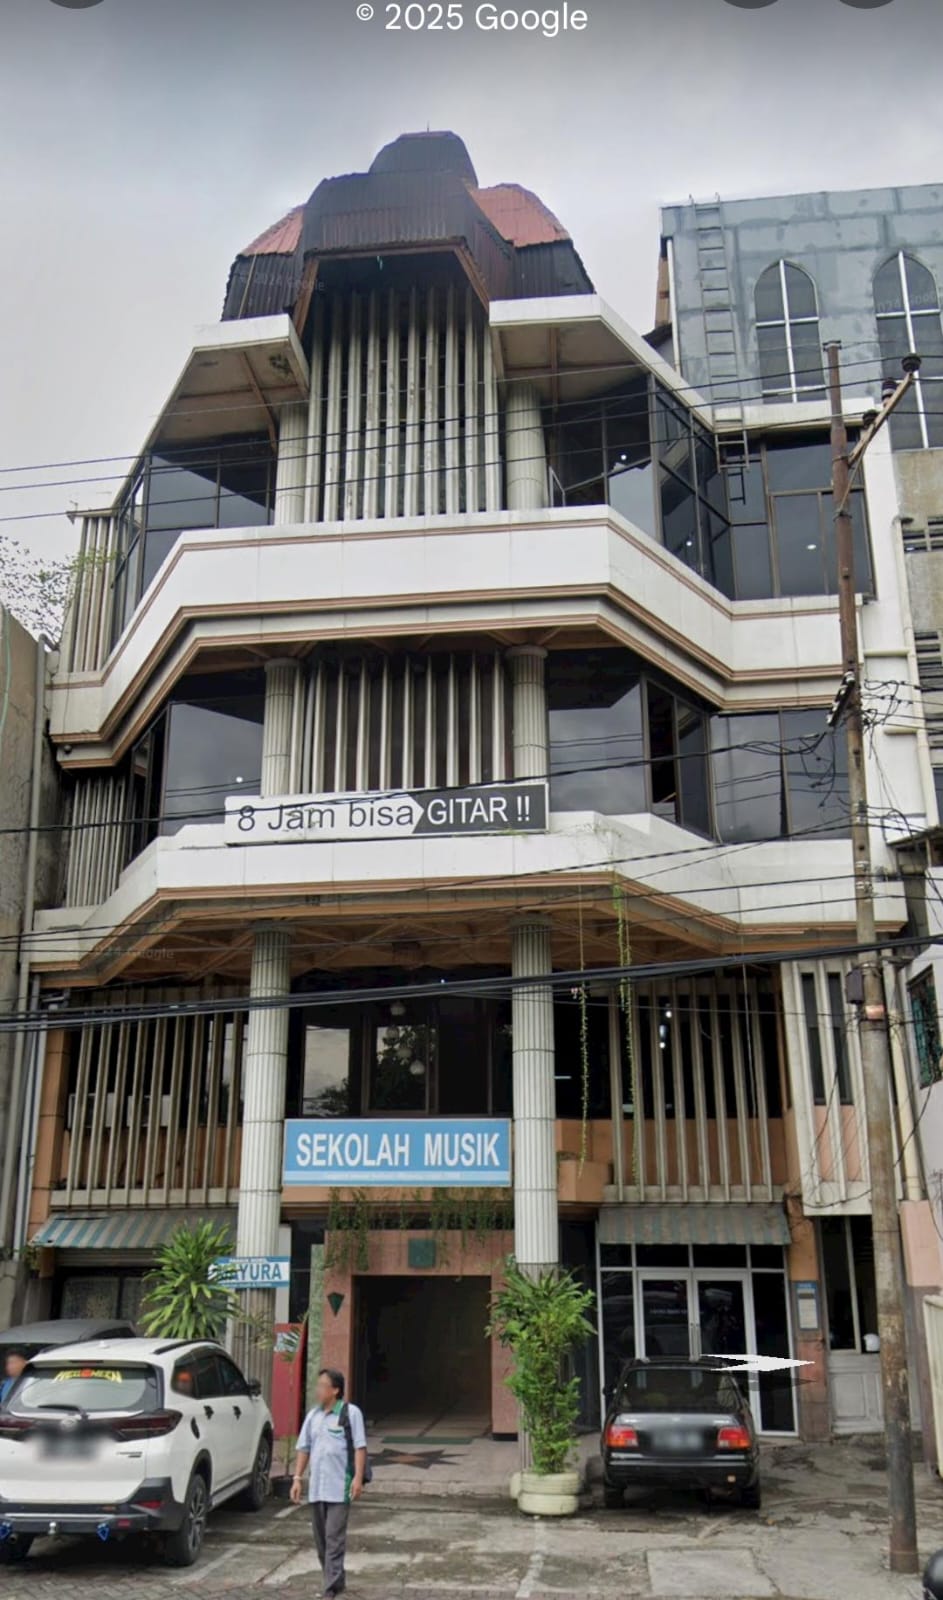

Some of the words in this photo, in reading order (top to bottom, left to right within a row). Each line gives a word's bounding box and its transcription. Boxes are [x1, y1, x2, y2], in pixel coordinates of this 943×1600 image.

[237, 805, 256, 832] 8
[267, 805, 336, 831] Jam
[348, 801, 414, 828] bisa
[426, 796, 507, 825] GITAR
[516, 796, 531, 822] !!
[296, 1132, 410, 1167] SEKOLAH
[423, 1132, 501, 1167] MUSIK
